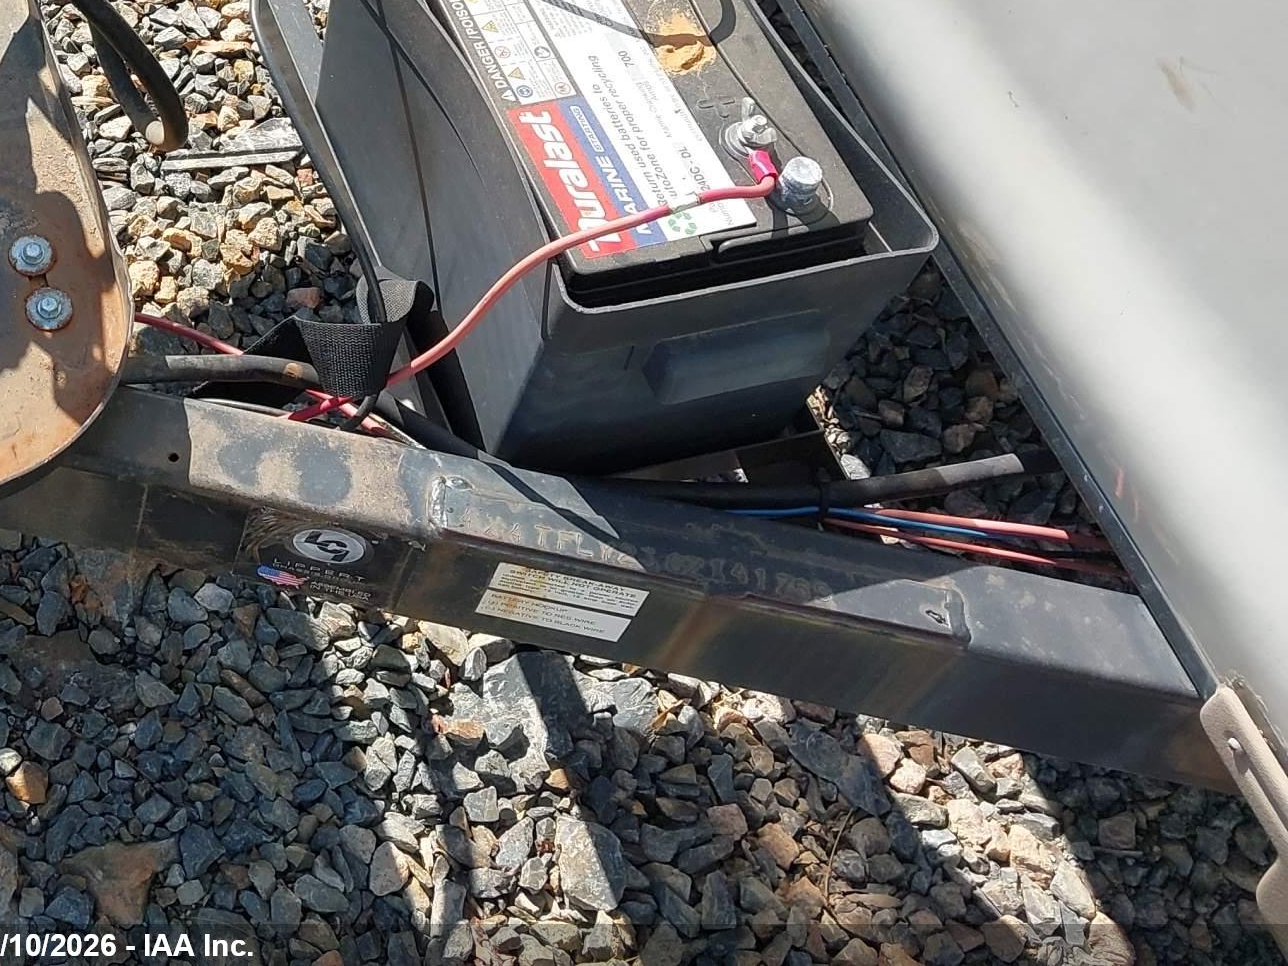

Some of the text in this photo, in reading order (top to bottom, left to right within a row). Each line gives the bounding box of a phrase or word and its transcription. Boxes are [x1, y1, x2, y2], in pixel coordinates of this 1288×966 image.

[617, 49, 635, 67] 700
[572, 106, 603, 151] STARTING
[587, 54, 679, 201] utoZone for proper recycling
[591, 83, 669, 207] Return used batteries to
[675, 145, 692, 159] DL
[518, 110, 622, 253] Duralast
[273, 557, 365, 582] LIPPERT
